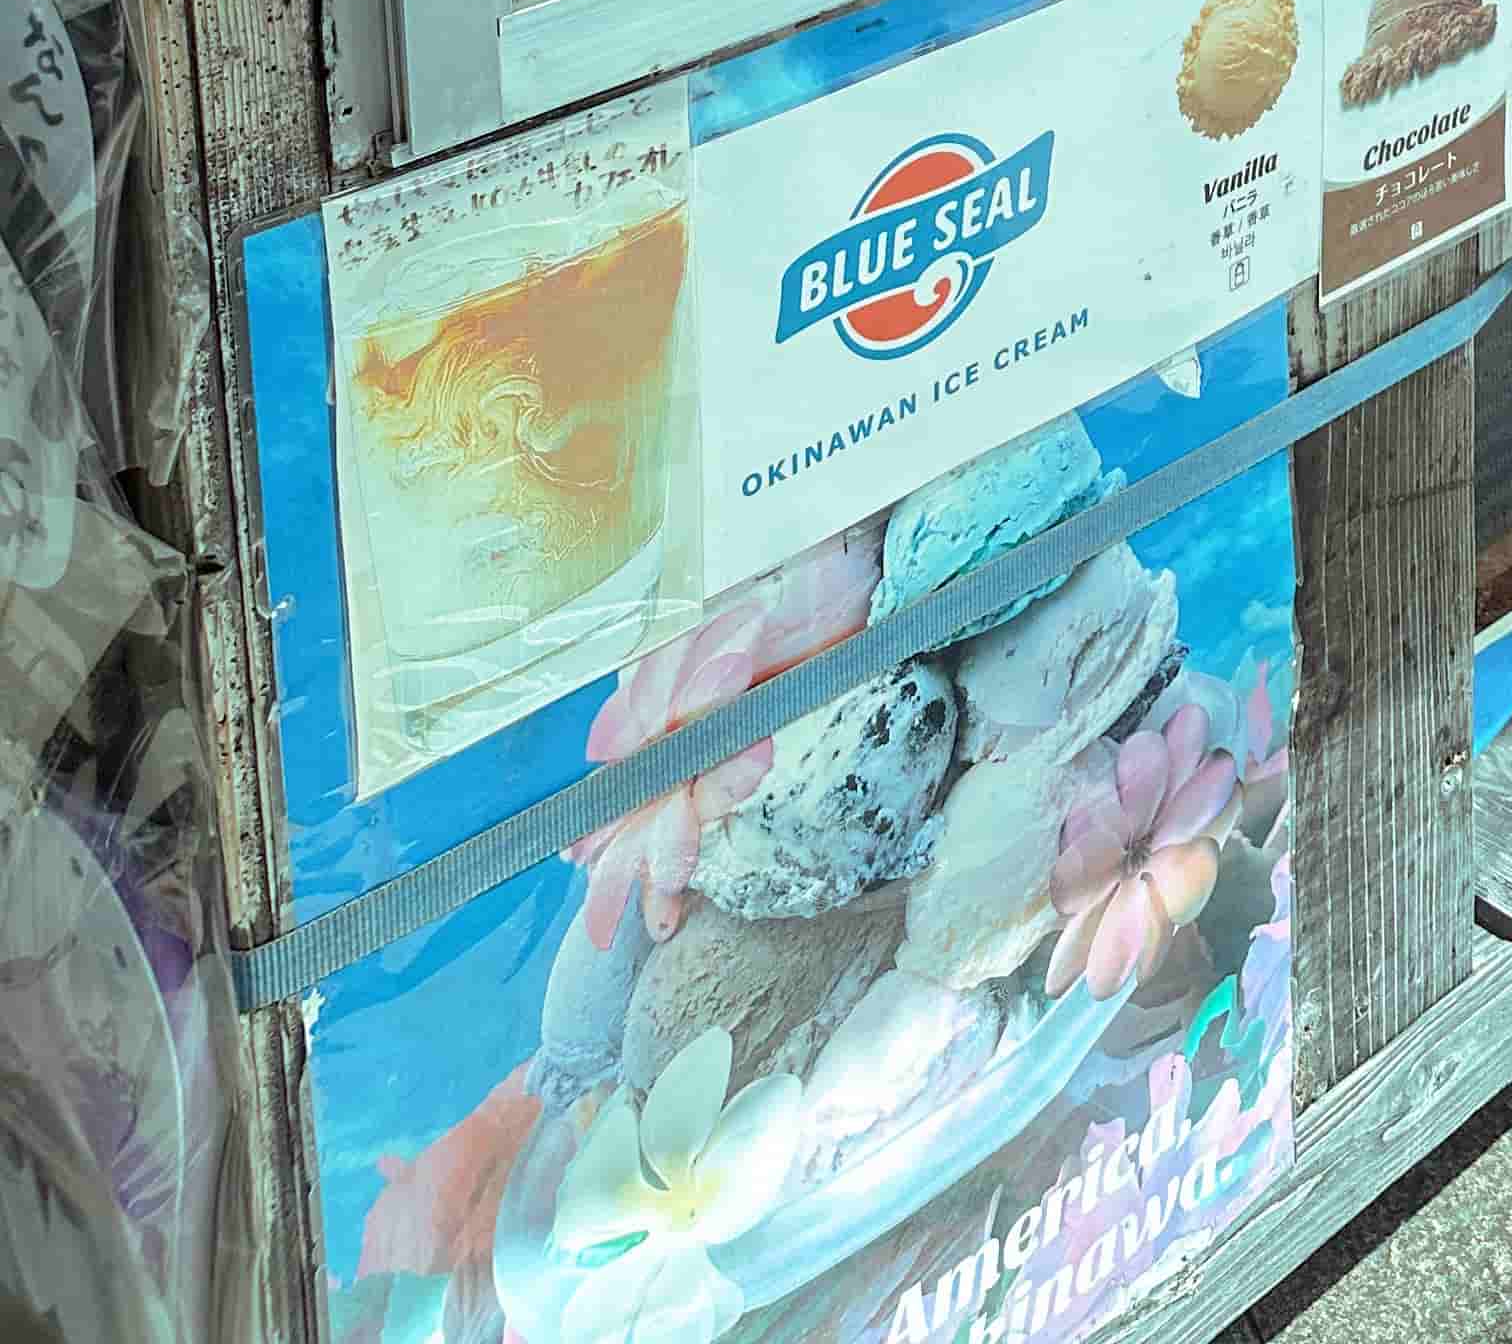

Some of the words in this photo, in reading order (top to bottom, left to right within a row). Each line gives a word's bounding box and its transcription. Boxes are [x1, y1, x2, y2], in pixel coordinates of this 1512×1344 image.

[1363, 103, 1472, 171] Chocolate
[1204, 152, 1278, 205] Vanilla
[1223, 189, 1258, 219] バニラ
[1376, 152, 1457, 206] チョコレート
[801, 217, 918, 313] BLUE
[933, 167, 1038, 252] SEAL
[741, 392, 917, 497] OKINAWAN
[933, 362, 980, 402] ICE
[993, 307, 1090, 371] CREAM
